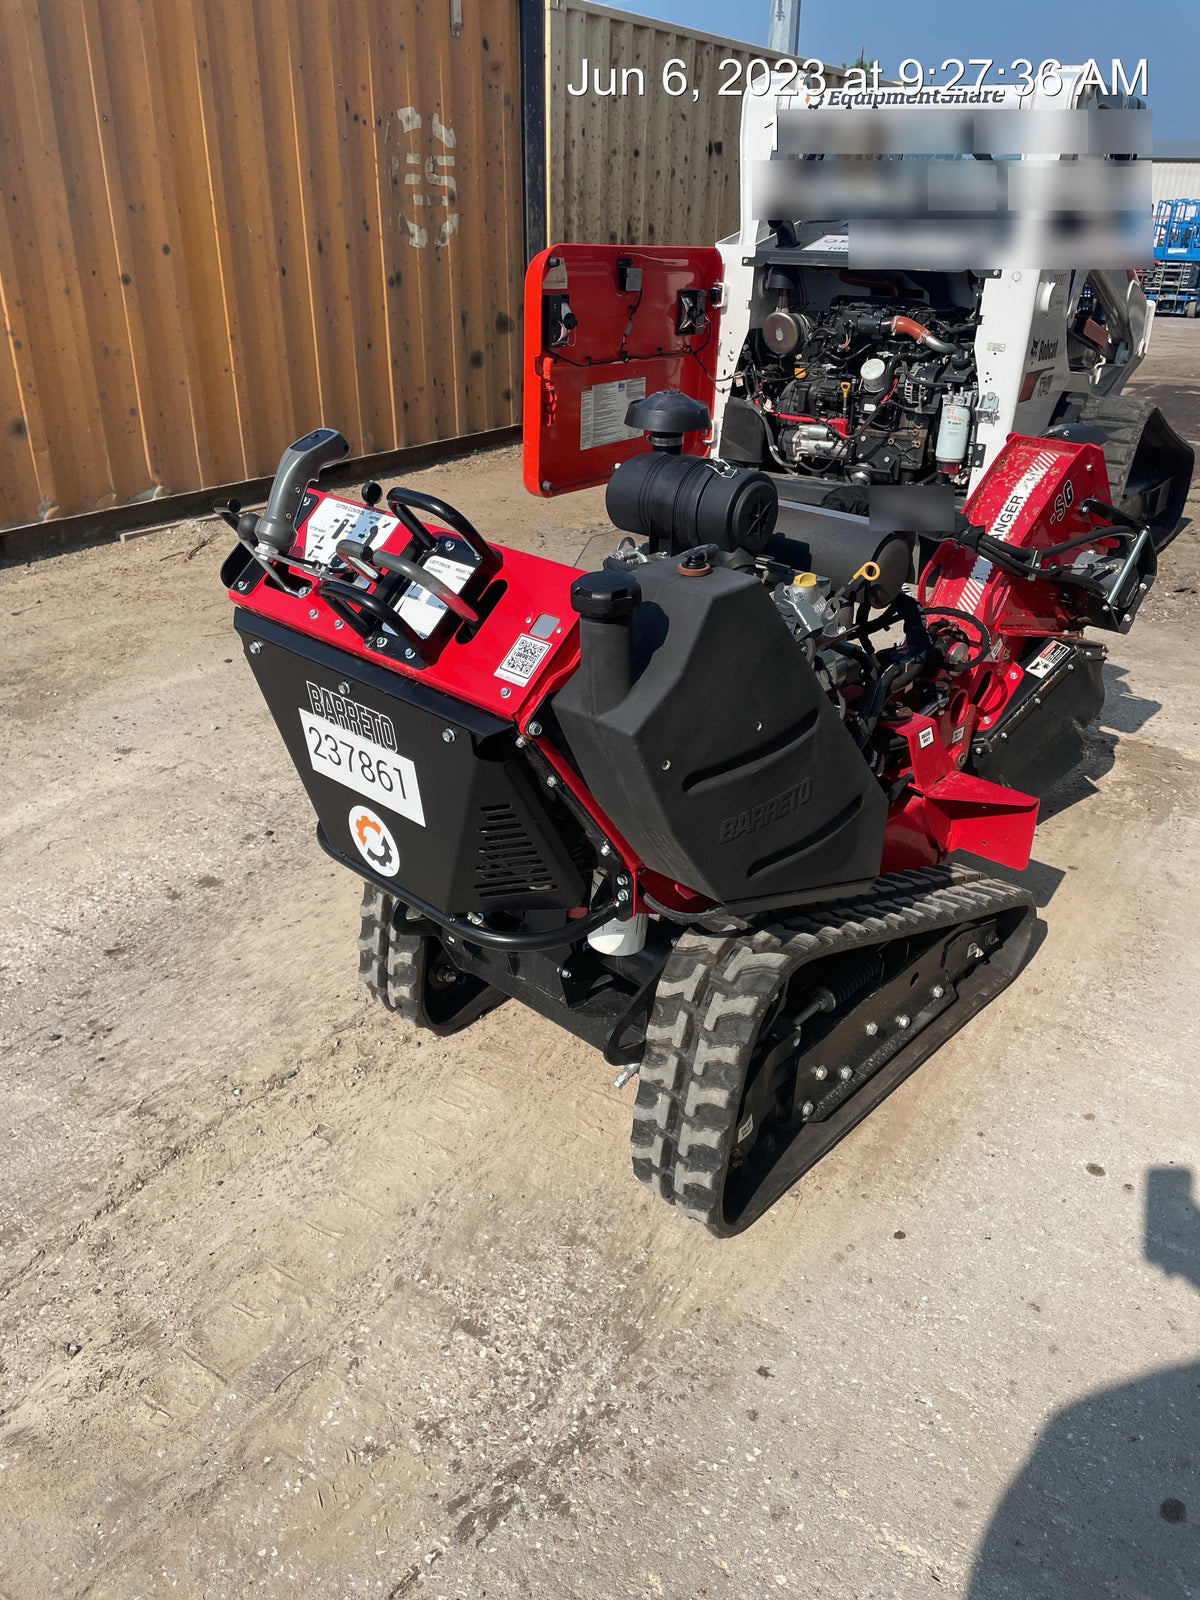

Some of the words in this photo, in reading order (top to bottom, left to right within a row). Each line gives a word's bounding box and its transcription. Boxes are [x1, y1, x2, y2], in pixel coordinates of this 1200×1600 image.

[993, 495, 1024, 541] ANGER
[305, 680, 398, 754] BARRETO
[308, 726, 407, 800] 237861
[719, 777, 812, 845] BARRETO
